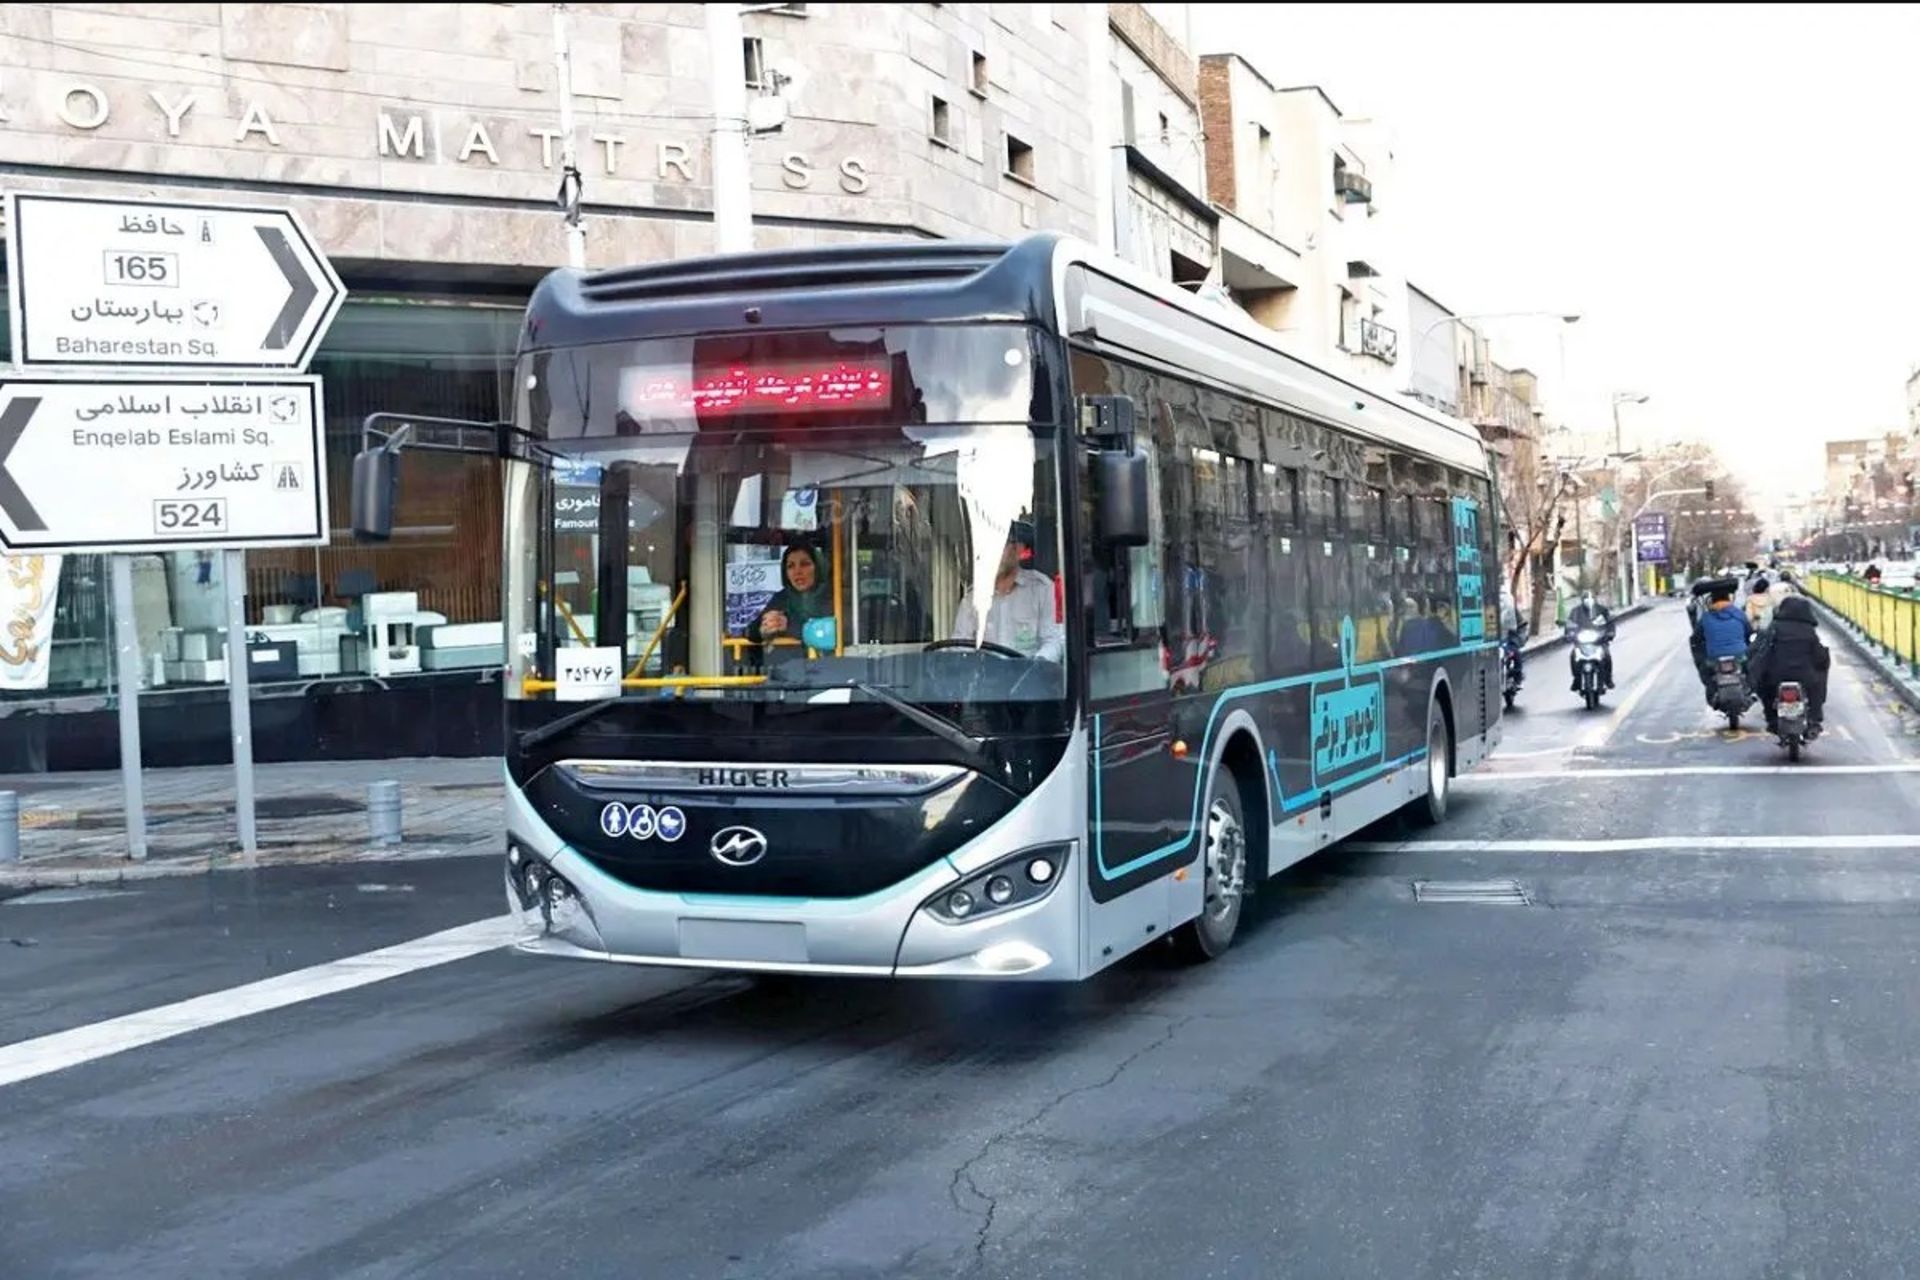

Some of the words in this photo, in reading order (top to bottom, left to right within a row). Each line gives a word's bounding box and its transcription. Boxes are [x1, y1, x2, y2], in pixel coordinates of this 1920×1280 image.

[0, 83, 280, 146] OYA
[377, 113, 868, 194] MATTRSS
[118, 215, 185, 235] حافظ
[114, 255, 167, 281] 165
[71, 298, 183, 325] بهارستان
[56, 336, 182, 355] Baharestan
[188, 339, 218, 357] Sq.
[76, 396, 170, 421] اسلامی
[180, 396, 262, 419] انقلاب
[73, 428, 160, 448] Enqelab
[169, 429, 235, 445] Eslami
[242, 428, 274, 446] Sq.
[177, 462, 263, 490] کشاورز
[161, 503, 221, 528] 524
[699, 768, 789, 787] HIGER
